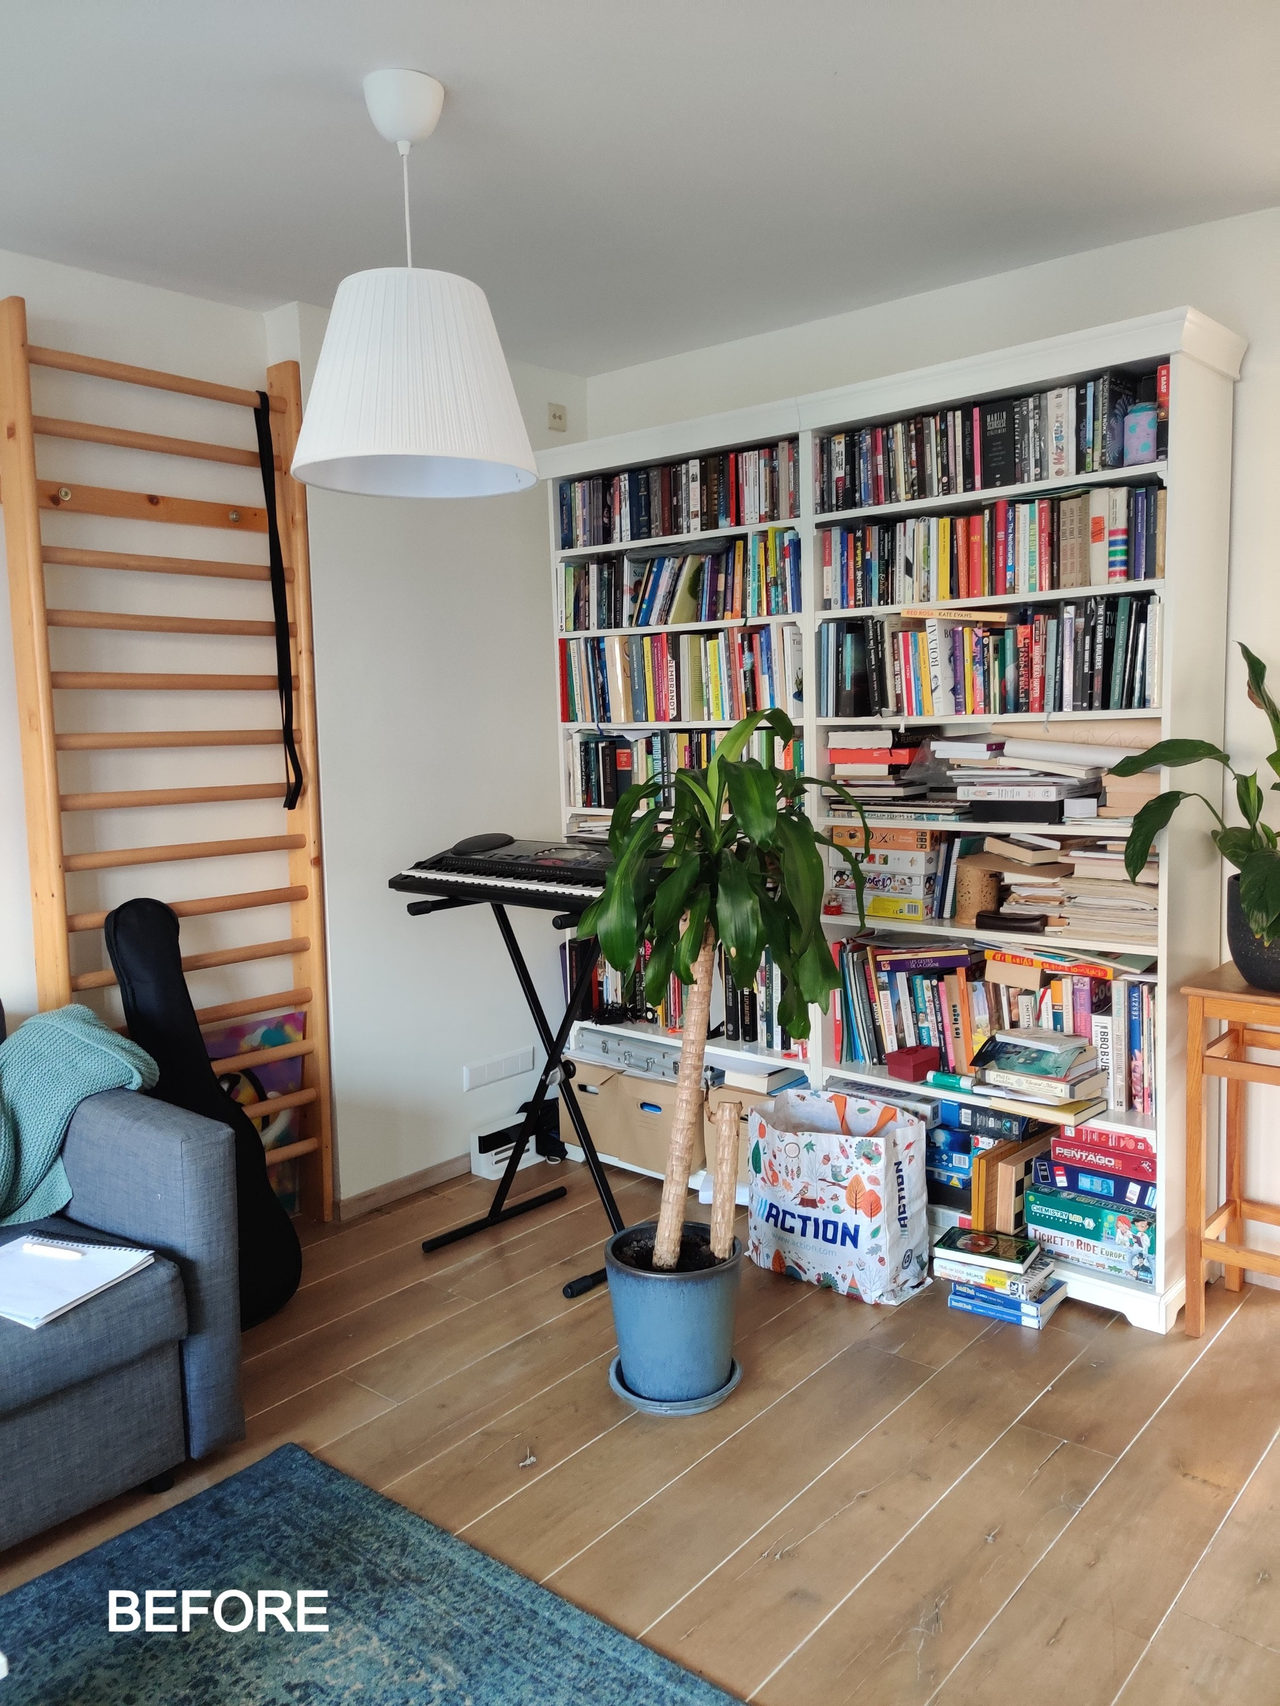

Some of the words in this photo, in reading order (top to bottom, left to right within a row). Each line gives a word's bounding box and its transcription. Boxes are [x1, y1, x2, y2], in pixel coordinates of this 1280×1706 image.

[927, 624, 939, 667] BOLYAI
[1095, 644, 1103, 670] BUILDERS
[668, 659, 676, 711] REMBRANDT
[951, 1004, 960, 1025] logos
[1055, 1146, 1116, 1167] PENTAGO
[894, 1161, 908, 1228] ACTION
[765, 1202, 861, 1249] ACTION
[1031, 1204, 1069, 1220] CHEMISTRY
[1032, 1228, 1065, 1247] TICKET
[1066, 1239, 1074, 1247] TO
[1076, 1239, 1098, 1255] RIDE
[1100, 1248, 1127, 1261] EUROPE
